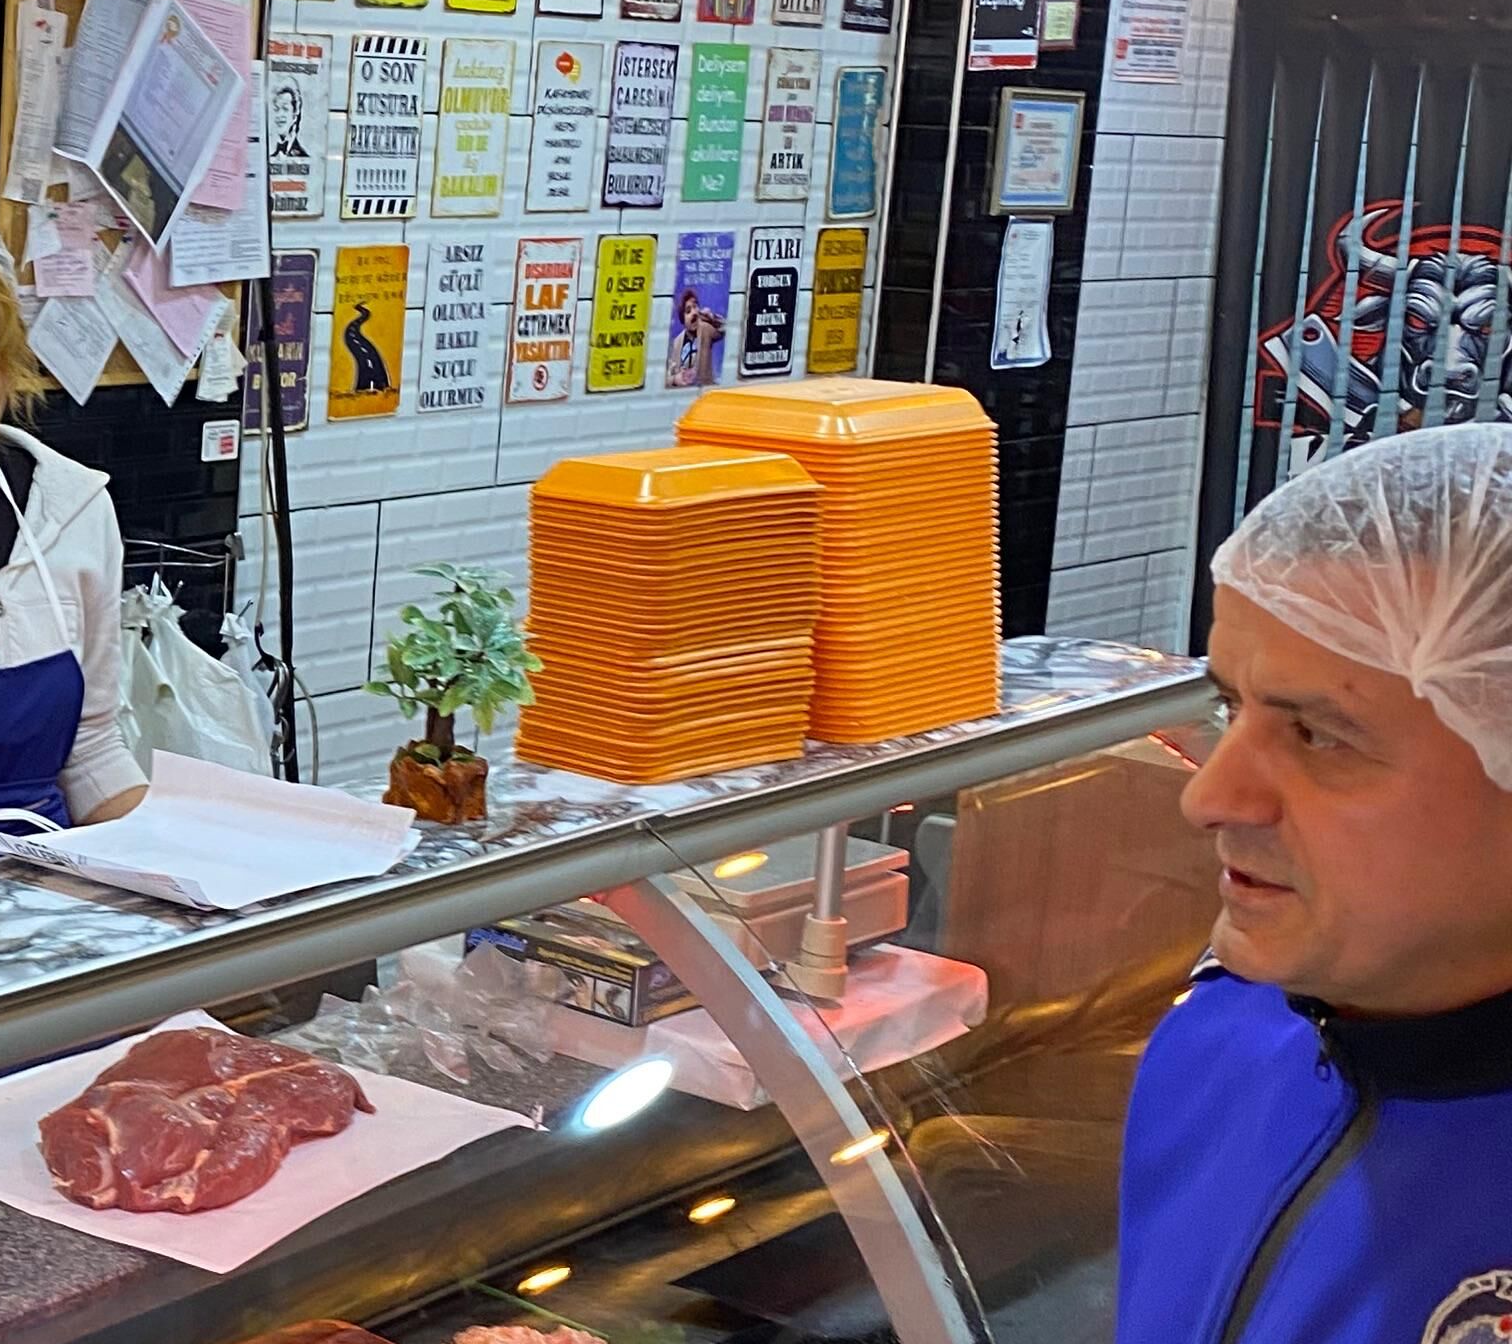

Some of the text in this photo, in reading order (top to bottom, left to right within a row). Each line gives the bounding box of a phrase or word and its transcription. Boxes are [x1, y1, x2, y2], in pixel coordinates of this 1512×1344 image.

[361, 60, 416, 85] O SON
[619, 52, 674, 79] İSTERSEK
[357, 92, 418, 117] KUSURA
[617, 85, 672, 110] ÇARESİNİ
[770, 152, 804, 169] ARTIK
[608, 174, 653, 196] BULURUZ
[630, 248, 644, 264] DE
[753, 238, 802, 261] UYARI
[439, 268, 484, 297] GÜÇLÜ
[606, 272, 645, 297] O İŞLER
[525, 284, 569, 310] LAF
[768, 293, 780, 306] VE
[432, 301, 485, 322] OLUNCA
[610, 299, 637, 320] ÖYLE
[435, 330, 478, 350] HAKLI
[431, 359, 477, 383] SUÇLU
